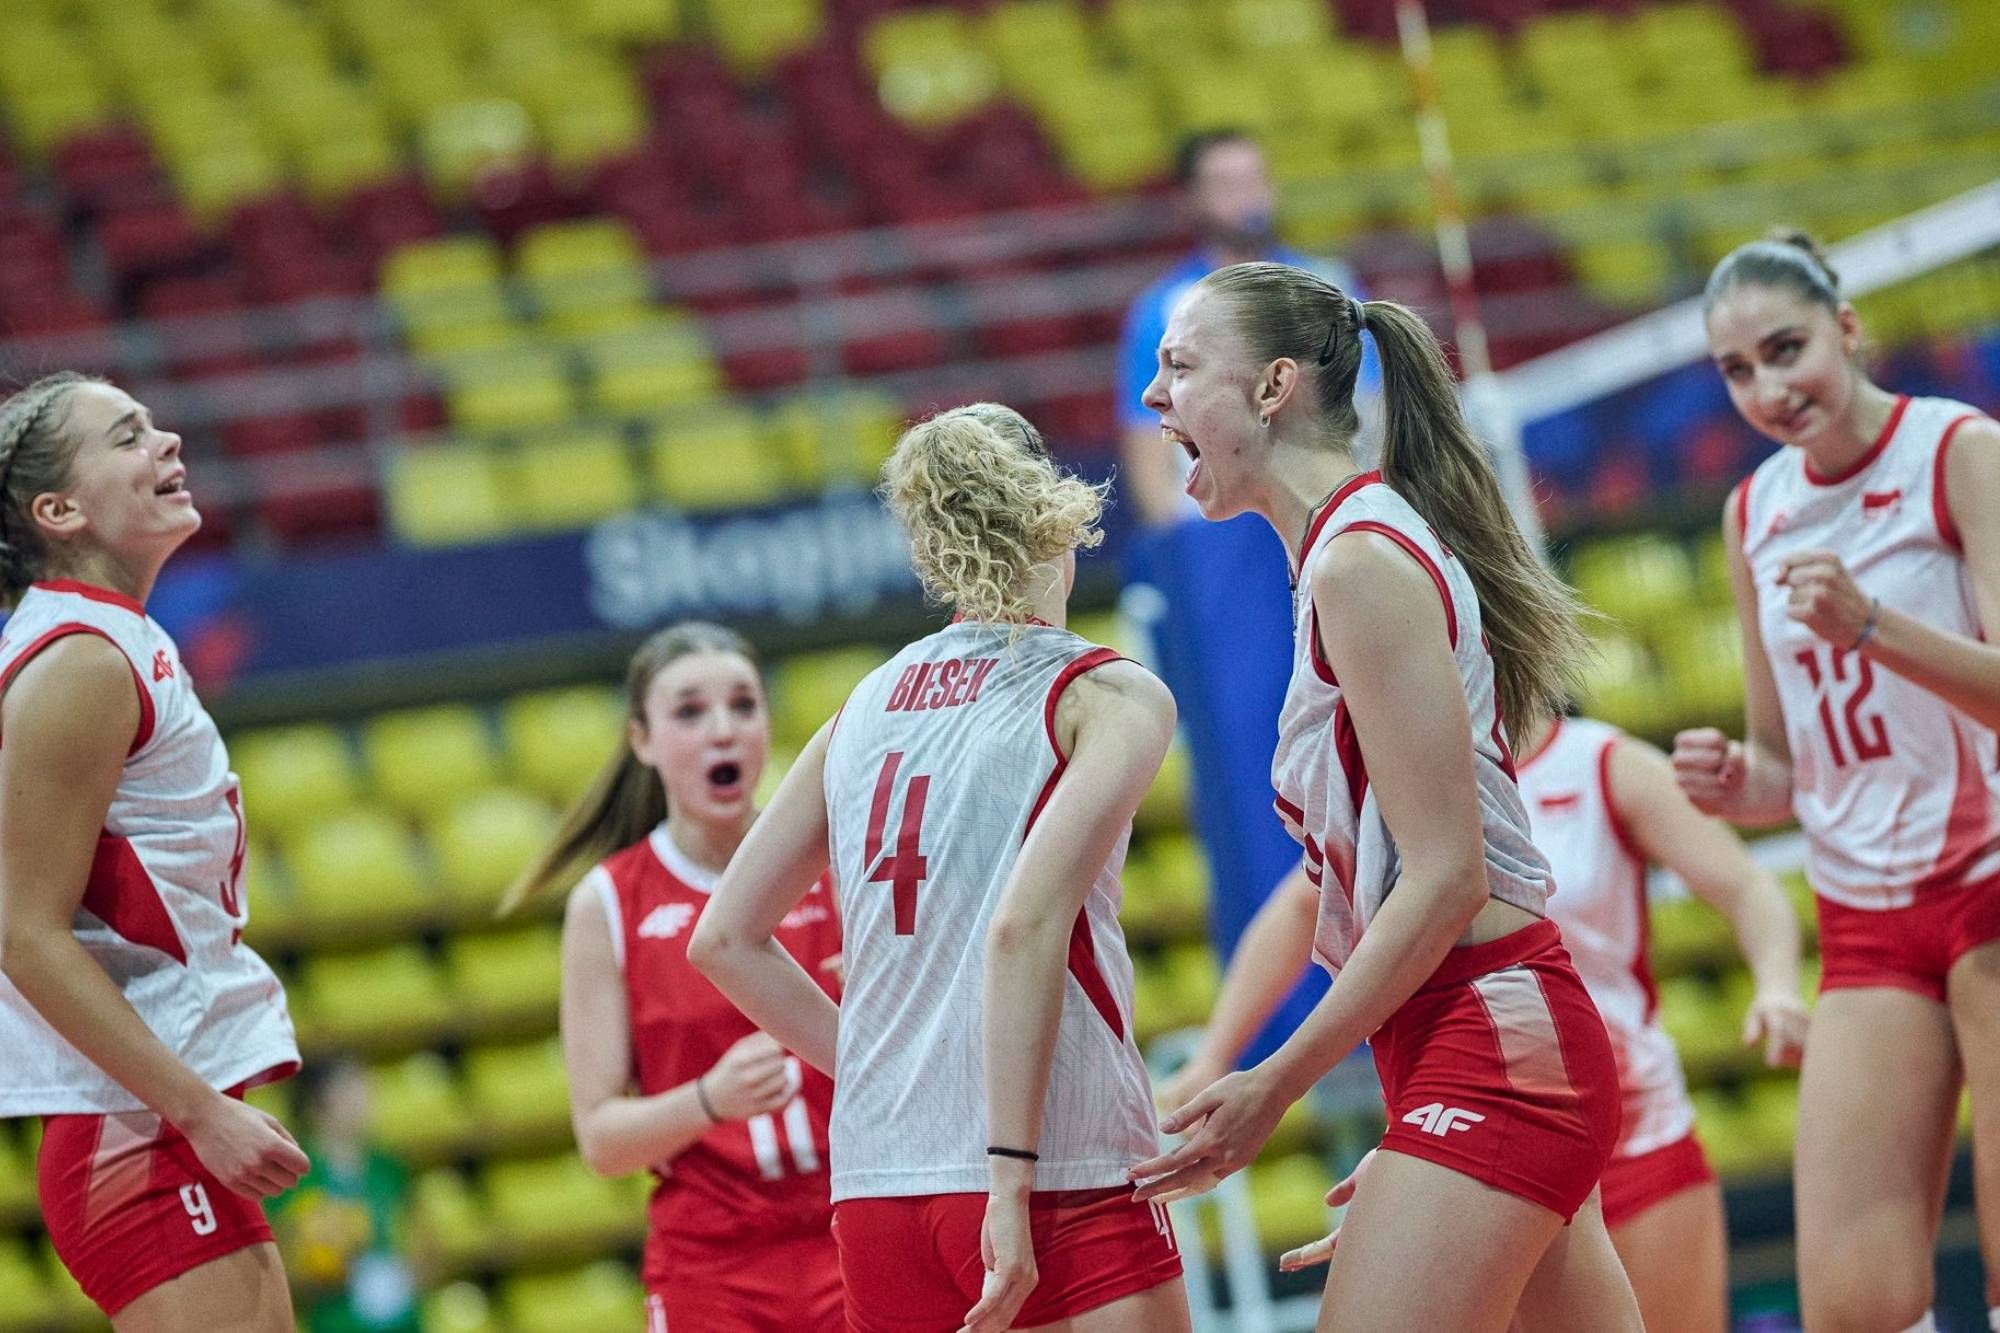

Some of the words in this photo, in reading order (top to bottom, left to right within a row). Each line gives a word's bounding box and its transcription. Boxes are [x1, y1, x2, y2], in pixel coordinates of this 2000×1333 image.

[885, 658, 1000, 712] BIESEK
[1796, 644, 1892, 769] 12
[864, 751, 931, 936] 4
[1401, 1102, 1486, 1137] 4F
[178, 1182, 217, 1236] 9
